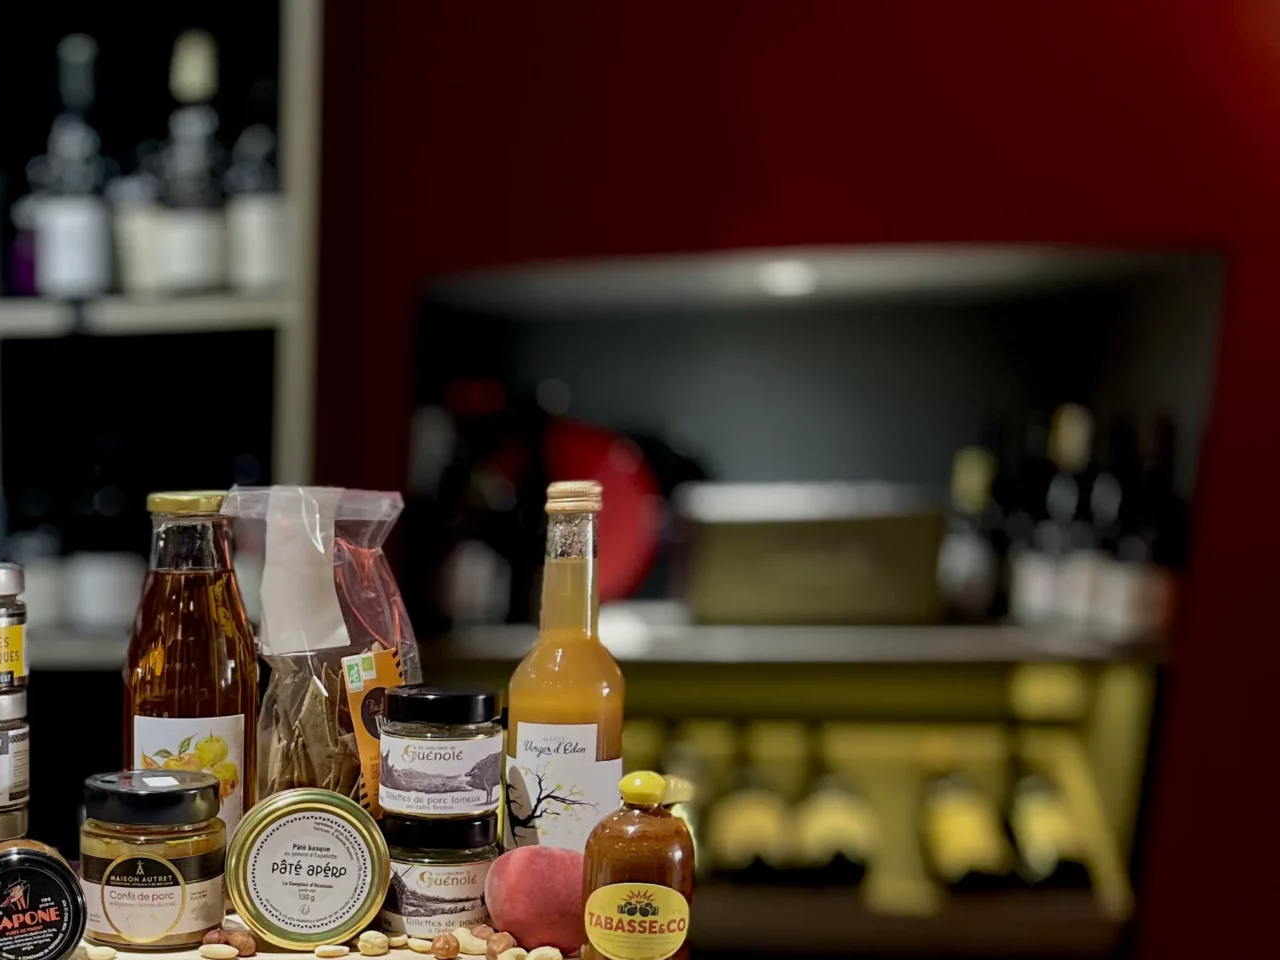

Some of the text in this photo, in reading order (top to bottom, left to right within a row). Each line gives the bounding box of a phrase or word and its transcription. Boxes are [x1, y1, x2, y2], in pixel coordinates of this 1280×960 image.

[401, 744, 464, 763] Guénolé
[523, 740, 552, 758] Verger
[427, 797, 449, 805] porc
[308, 844, 331, 853] basque
[416, 870, 477, 888] Guénolé
[109, 890, 175, 902] Confit de porc
[299, 893, 316, 902] 130 g
[406, 918, 442, 927] Rillettes
[445, 918, 457, 927] de
[588, 911, 686, 935] TABASSE&CO
